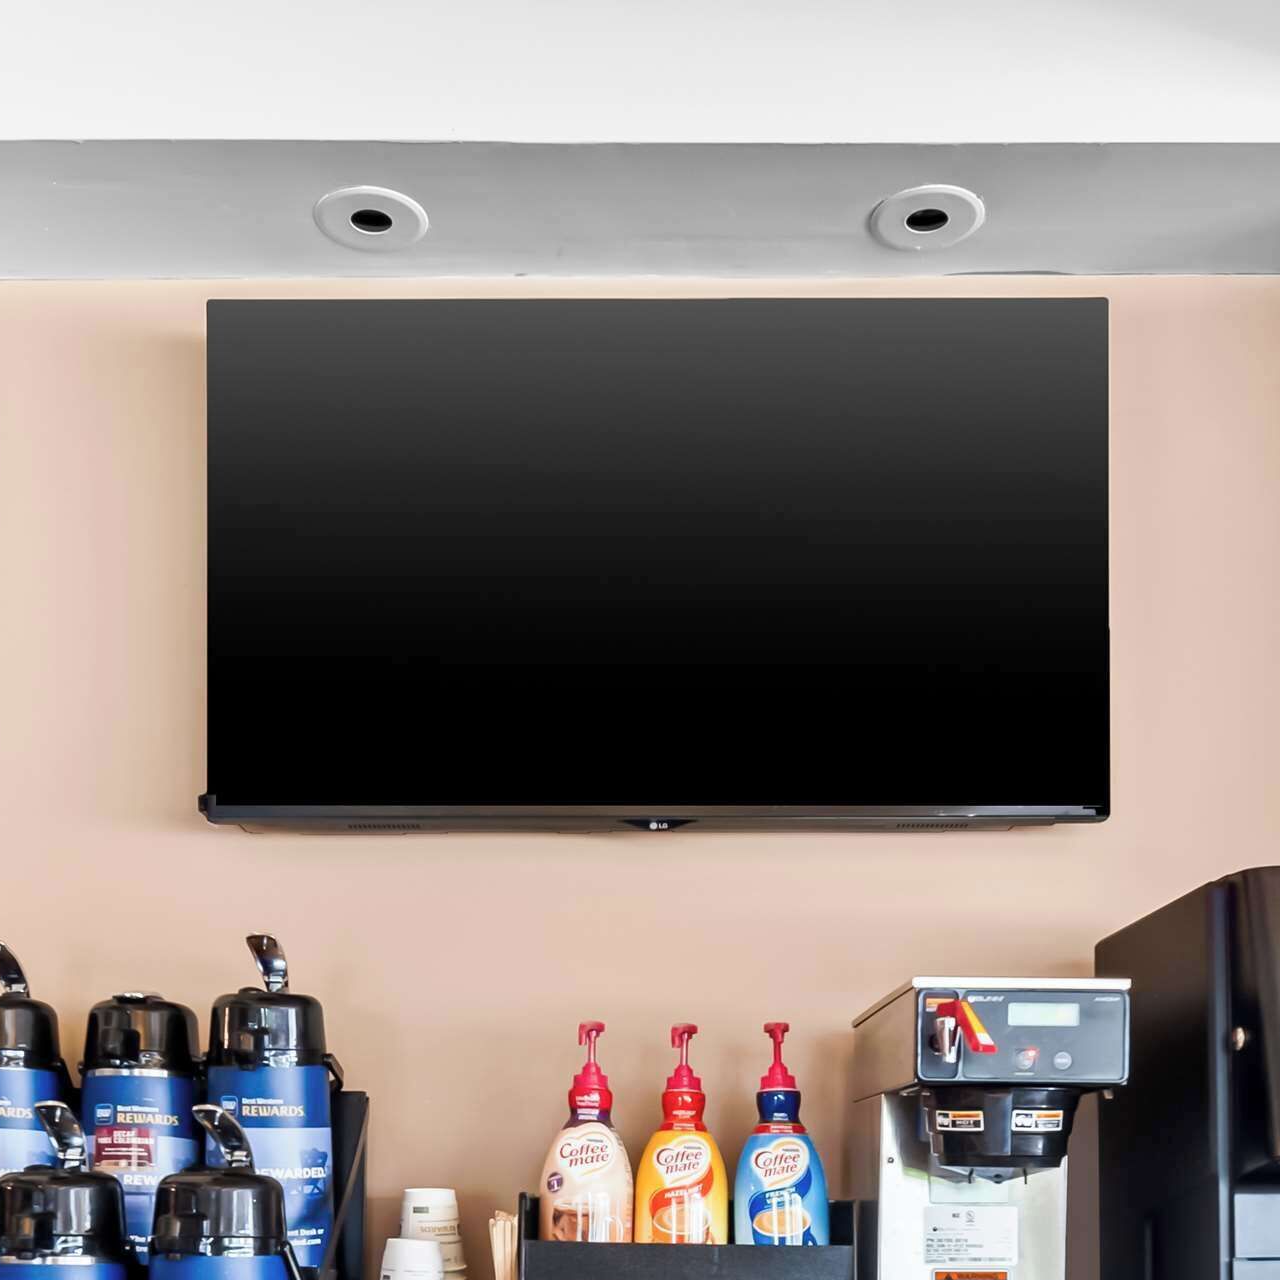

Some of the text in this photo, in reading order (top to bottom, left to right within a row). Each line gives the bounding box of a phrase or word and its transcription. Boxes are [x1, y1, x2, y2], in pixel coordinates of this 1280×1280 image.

[241, 1105, 304, 1117] REWARDS
[117, 1112, 179, 1126] REWARDS
[560, 1142, 608, 1159] Coffee
[656, 1147, 703, 1167] Coffee
[569, 1153, 609, 1168] mate
[665, 1160, 700, 1175] mate
[755, 1151, 800, 1169] Coffee
[763, 1163, 798, 1178] mate
